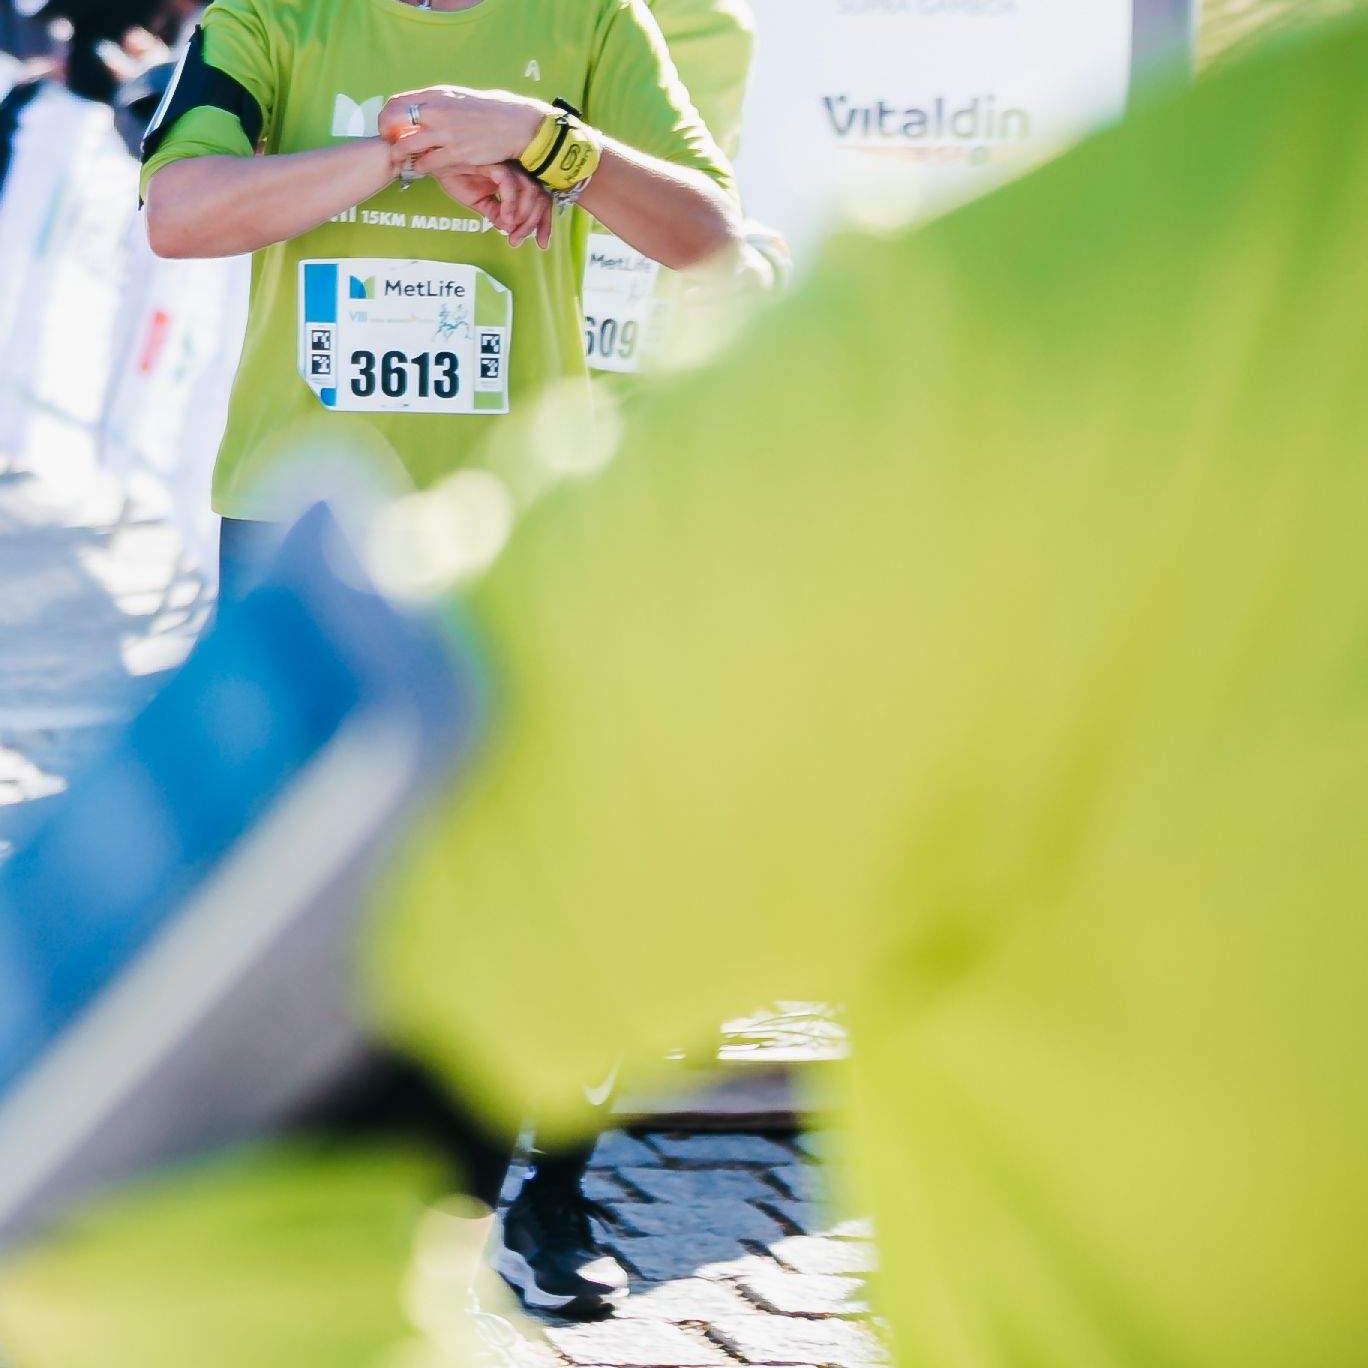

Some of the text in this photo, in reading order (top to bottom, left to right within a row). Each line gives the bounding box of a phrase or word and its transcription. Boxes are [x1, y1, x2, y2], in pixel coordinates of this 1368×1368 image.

[361, 209, 406, 228] 15KM
[411, 215, 481, 232] MADRID
[383, 279, 466, 298] MetLife
[350, 350, 460, 399] 3613
